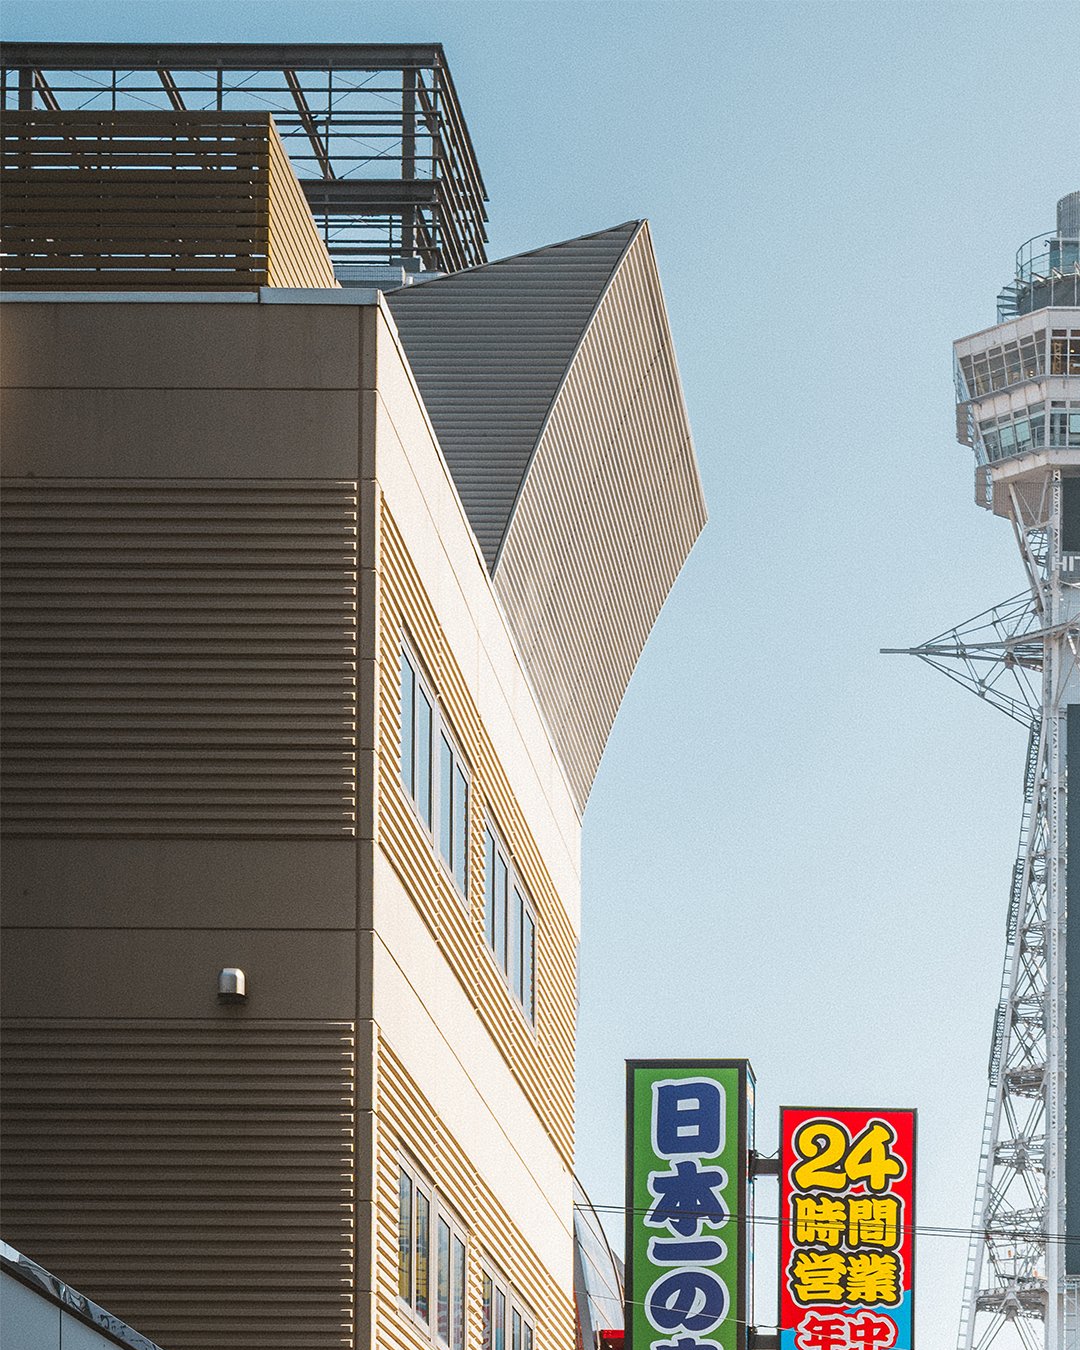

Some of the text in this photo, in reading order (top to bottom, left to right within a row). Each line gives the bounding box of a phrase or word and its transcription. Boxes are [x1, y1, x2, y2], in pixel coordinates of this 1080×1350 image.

[794, 1120, 903, 1192] 24
[796, 1197, 898, 1248] 時間
[794, 1252, 898, 1302] 営業
